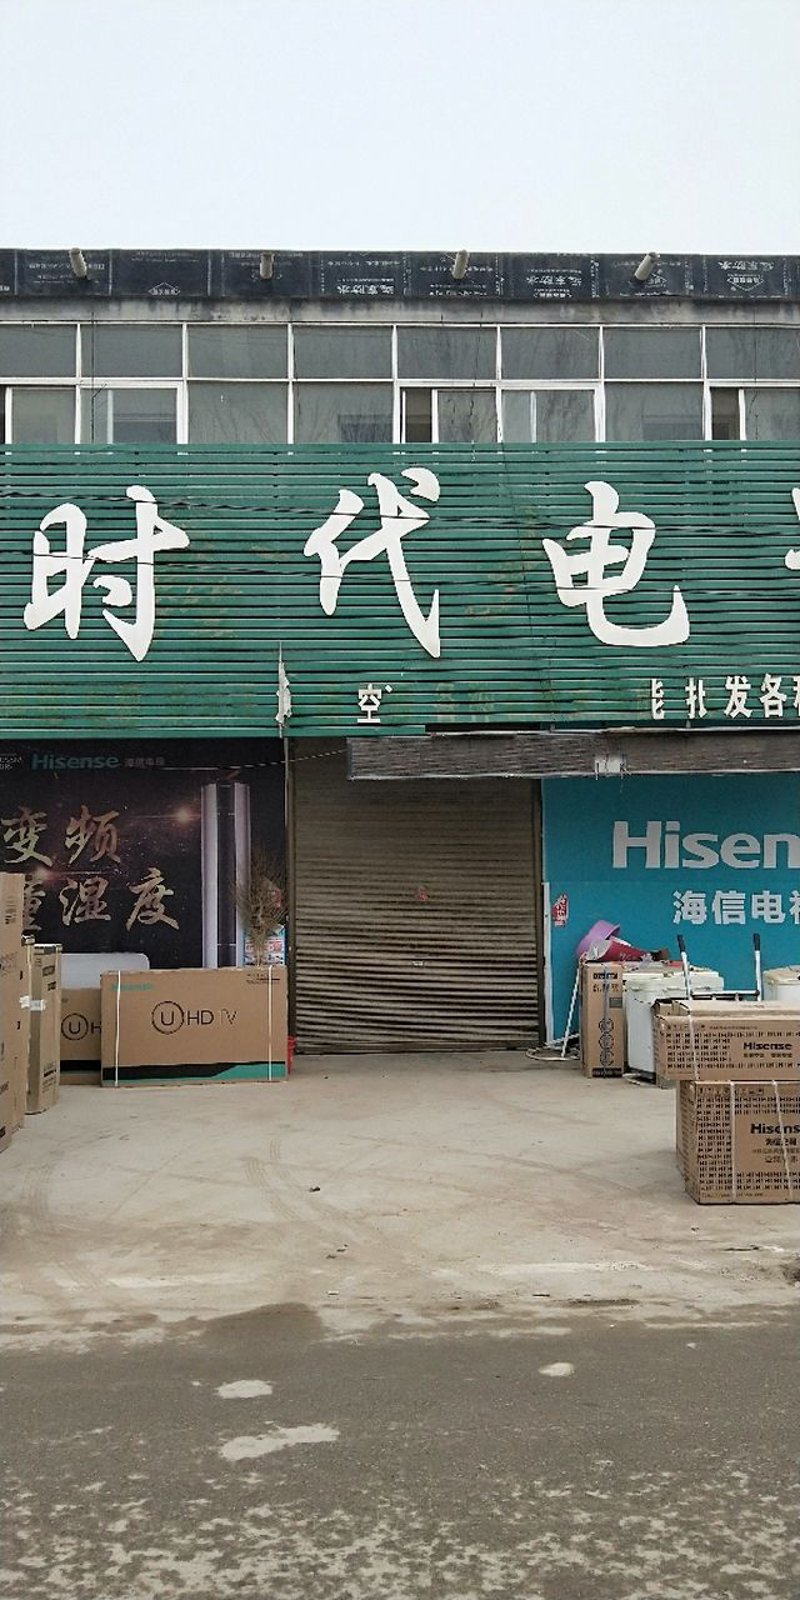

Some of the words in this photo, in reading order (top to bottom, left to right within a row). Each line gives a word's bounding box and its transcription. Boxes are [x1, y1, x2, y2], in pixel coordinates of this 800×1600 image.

[24, 467, 800, 661] 时代电
[31, 752, 120, 771] Hisense
[1, 805, 122, 867] 变频
[743, 1041, 792, 1051] Hisense
